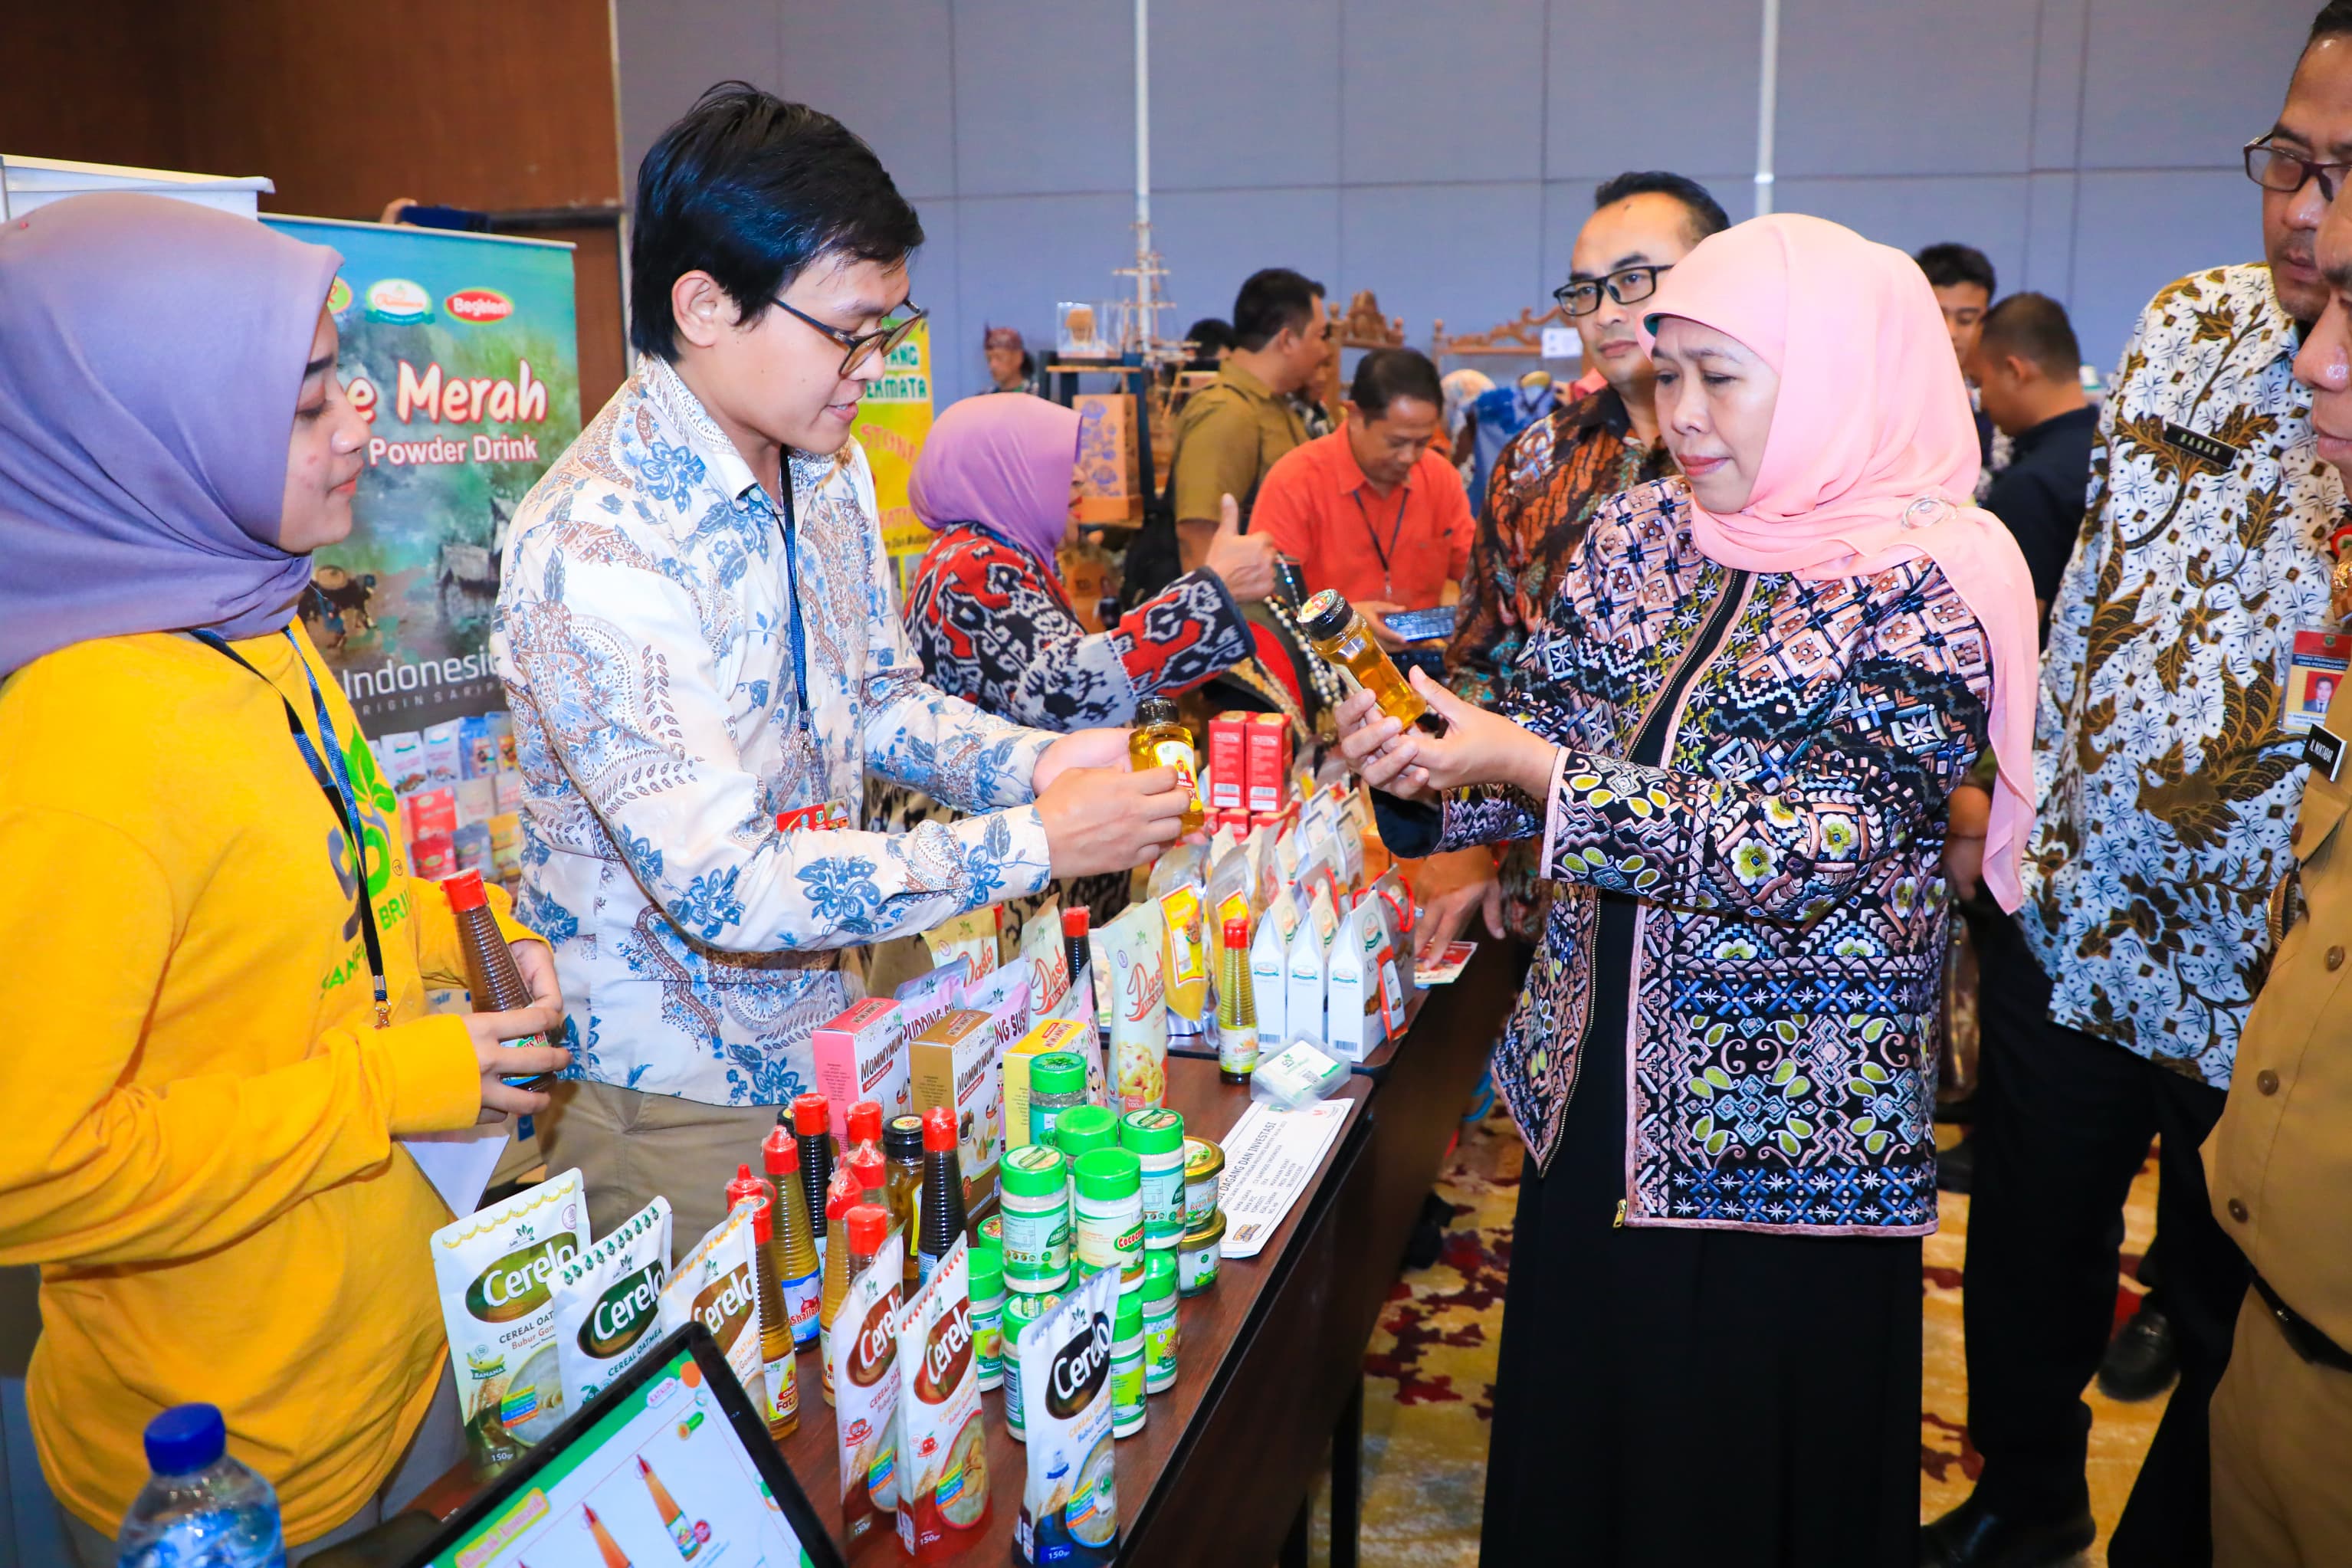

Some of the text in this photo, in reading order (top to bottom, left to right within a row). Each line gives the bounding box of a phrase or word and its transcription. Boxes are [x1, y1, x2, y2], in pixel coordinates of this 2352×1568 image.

[884, 344, 918, 366] ANG
[396, 357, 548, 425] Merah
[368, 434, 539, 467] Powder Drink
[861, 1032, 903, 1082] MOMMYMUM
[956, 1043, 995, 1096] MOMMYMUM
[1225, 1166, 1245, 1192] DAGANG
[1238, 1151, 1254, 1169] DAN
[1251, 1121, 1278, 1153] INVESTASI
[483, 1241, 576, 1307] Cerelo
[594, 1267, 665, 1341] Cerelo
[499, 1323, 535, 1344] CEREAL
[511, 1335, 536, 1350] Bubur
[474, 1366, 504, 1379] BANANA
[608, 1354, 636, 1376] CEREAL
[491, 1452, 514, 1462] 150gr
[1048, 1550, 1070, 1560] 150gr
